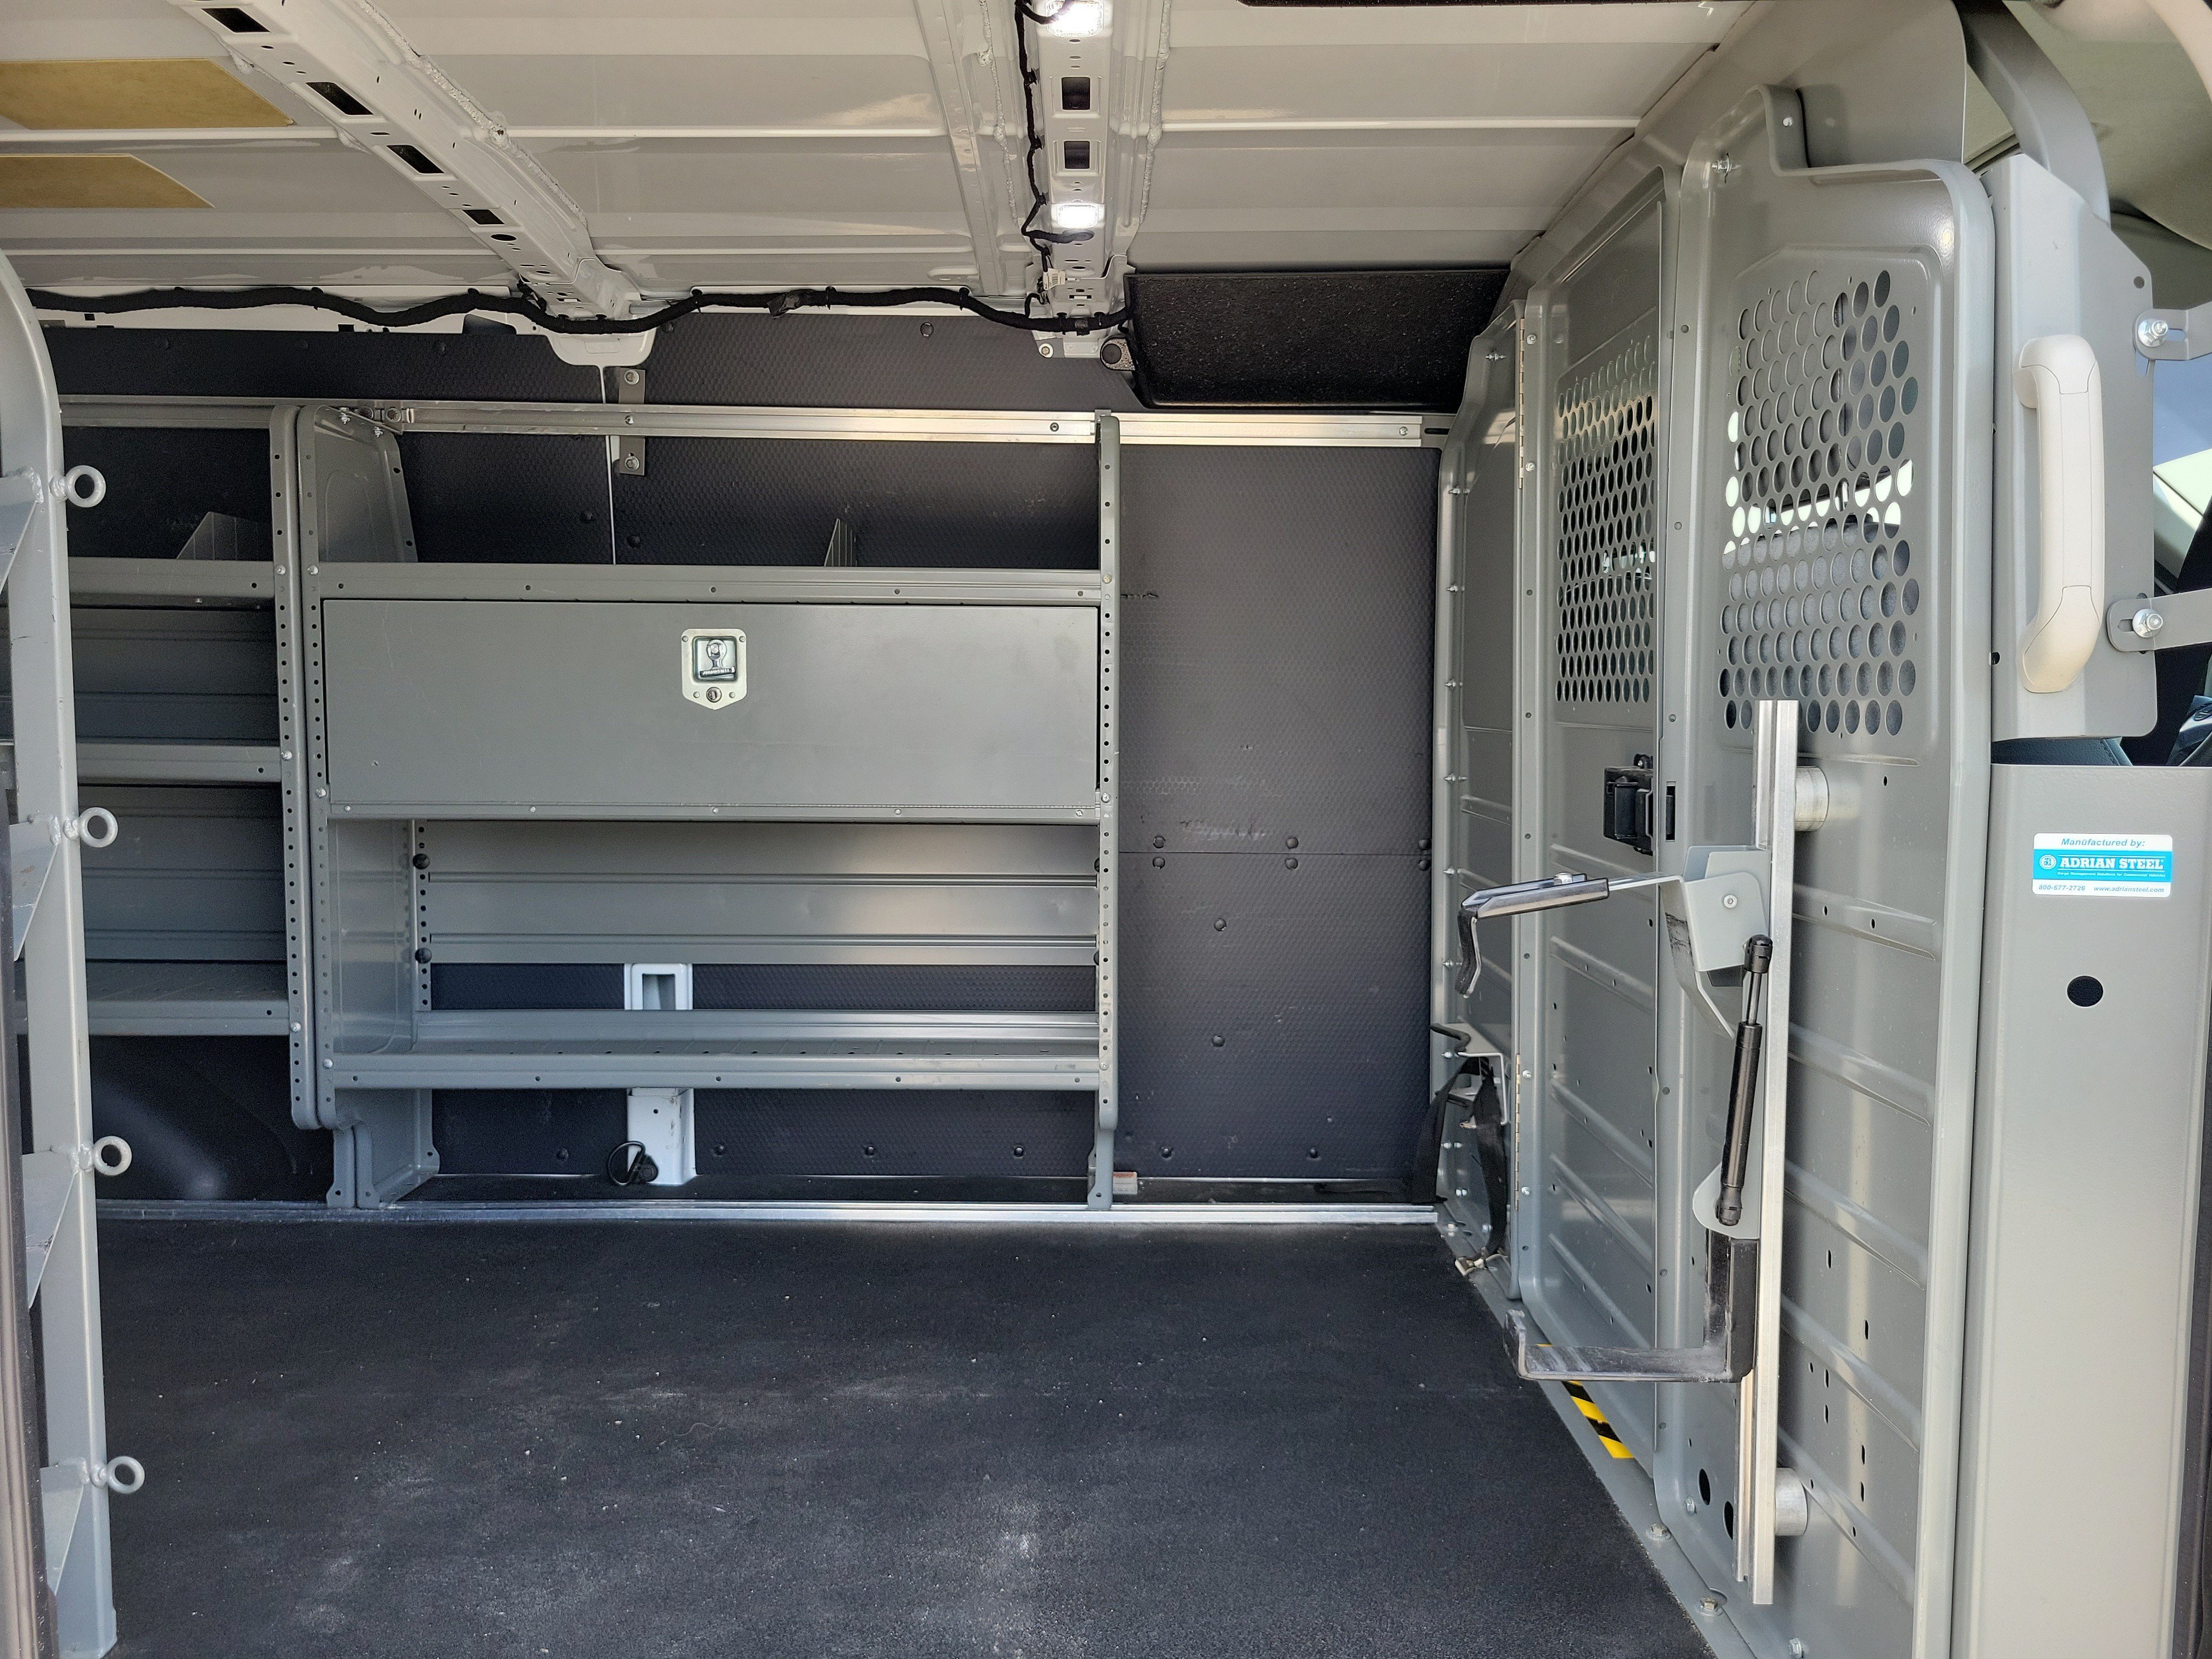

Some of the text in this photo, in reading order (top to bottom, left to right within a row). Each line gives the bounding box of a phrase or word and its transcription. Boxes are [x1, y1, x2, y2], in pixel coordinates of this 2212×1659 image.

[2130, 839, 2146, 848] by:
[2059, 857, 2164, 870] ADRIAN STEEL
